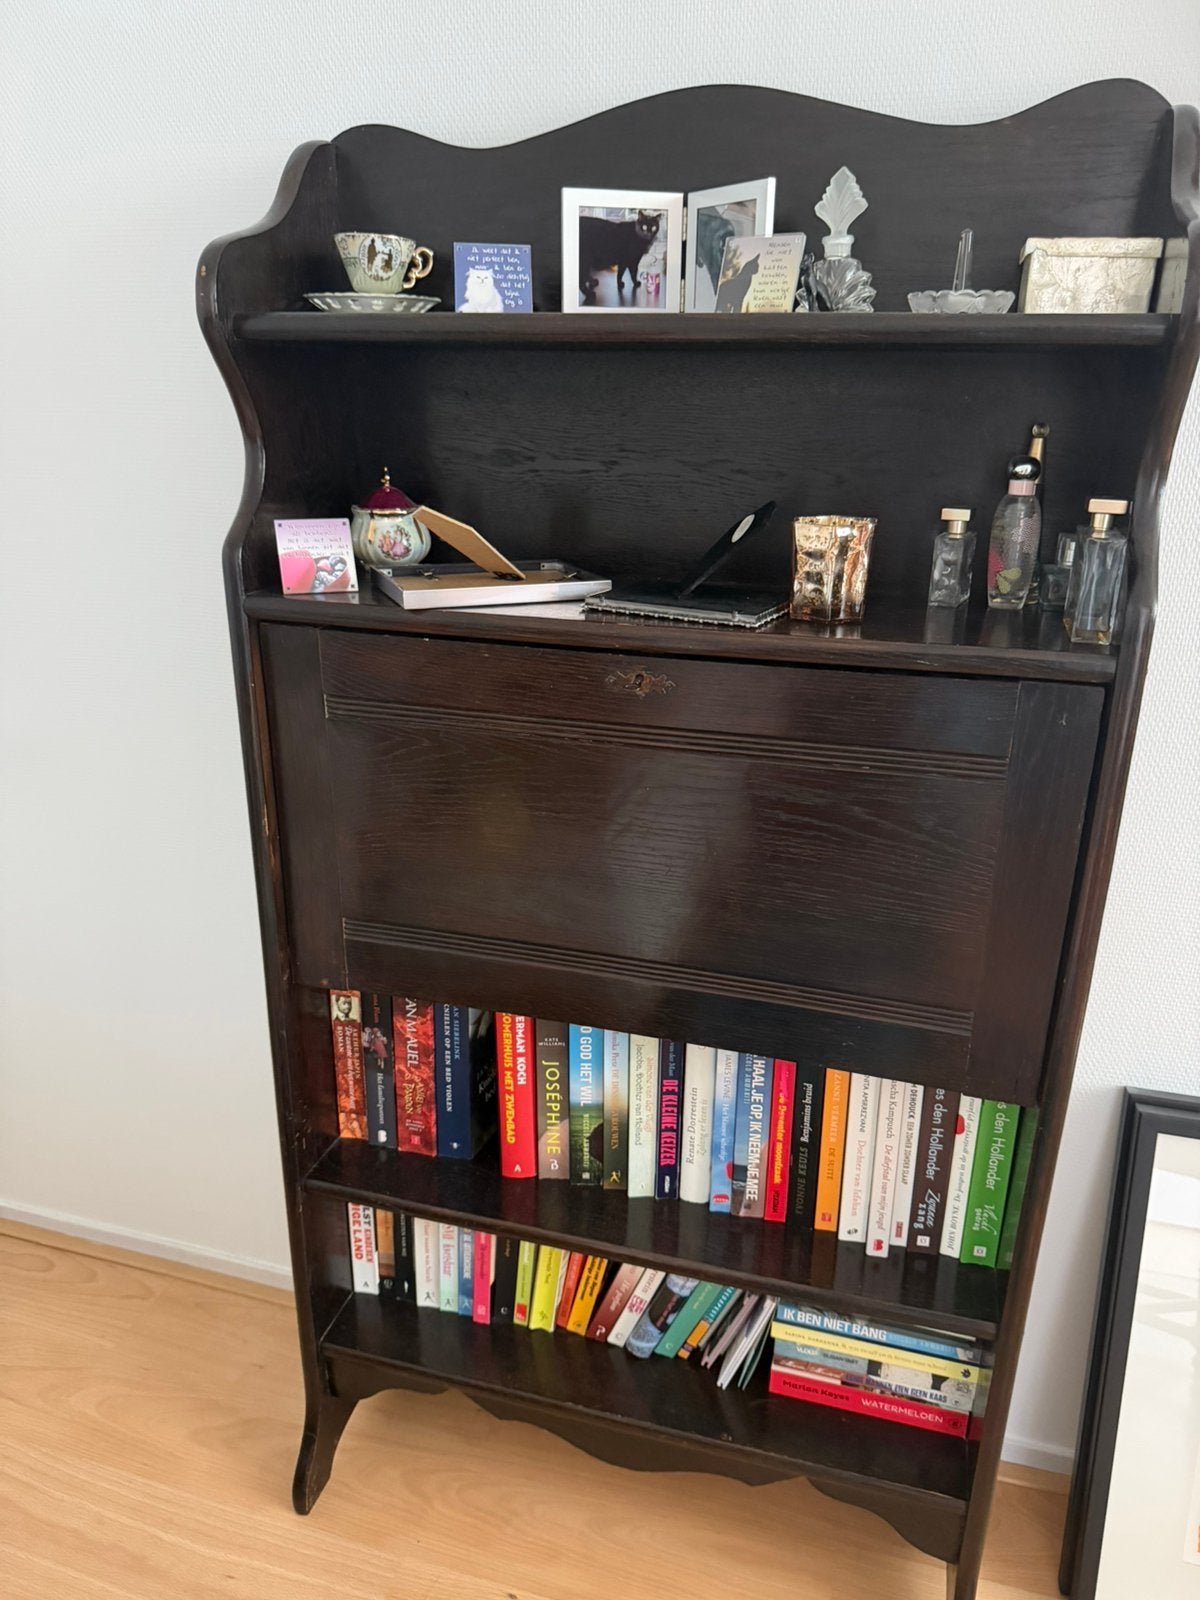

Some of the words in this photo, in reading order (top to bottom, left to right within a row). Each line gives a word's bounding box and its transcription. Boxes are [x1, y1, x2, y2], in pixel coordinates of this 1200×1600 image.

[405, 998, 417, 1018] AN
[444, 1038, 450, 1048] OP
[516, 1016, 525, 1054] ERMAN
[406, 1035, 419, 1067] AUEL
[580, 1038, 591, 1060] GOD
[504, 1071, 514, 1091] MET
[516, 1057, 526, 1085] KOCH
[580, 1063, 592, 1083] HET
[752, 1060, 765, 1087] HAAL
[580, 1086, 592, 1106] WIL
[663, 1080, 678, 1092] DE
[752, 1089, 764, 1103] JE
[803, 1083, 813, 1104] bruid
[936, 1088, 945, 1100] es
[505, 1093, 516, 1144] ZWEMBAD
[542, 1060, 563, 1154] JOSÉPHINE
[662, 1096, 678, 1130] KLEINE
[688, 1088, 698, 1133] Dorrestein
[749, 1105, 763, 1120] OP,
[932, 1104, 948, 1123] den
[750, 1122, 761, 1135] IK
[777, 1105, 787, 1140] Deventer
[800, 1104, 813, 1143] Benjamins
[886, 1101, 897, 1139] Kampusch
[995, 1113, 1010, 1134] den
[660, 1132, 676, 1166] KEIZER
[686, 1134, 695, 1164] Renate
[748, 1134, 760, 1162] NEEM
[828, 1148, 835, 1157] DE
[856, 1140, 866, 1170] Dochter
[886, 1145, 893, 1155] De
[926, 1128, 944, 1180] Hollander
[799, 1146, 808, 1176] KEULS
[986, 1137, 1006, 1191] Hollander
[746, 1178, 758, 1201] MEE
[362, 1207, 371, 1226] LST
[913, 1203, 926, 1229] zang
[353, 1229, 363, 1260] LAND
[784, 1308, 795, 1320] IK
[797, 1310, 821, 1327] BEN
[824, 1317, 851, 1333] NIET
[852, 1322, 887, 1340] BANG
[783, 1380, 818, 1394] Marian
[821, 1389, 850, 1400] Keyes
[911, 1387, 927, 1397] GEEN
[929, 1391, 947, 1403] KAAS
[861, 1398, 943, 1423] WATERMELOEN
